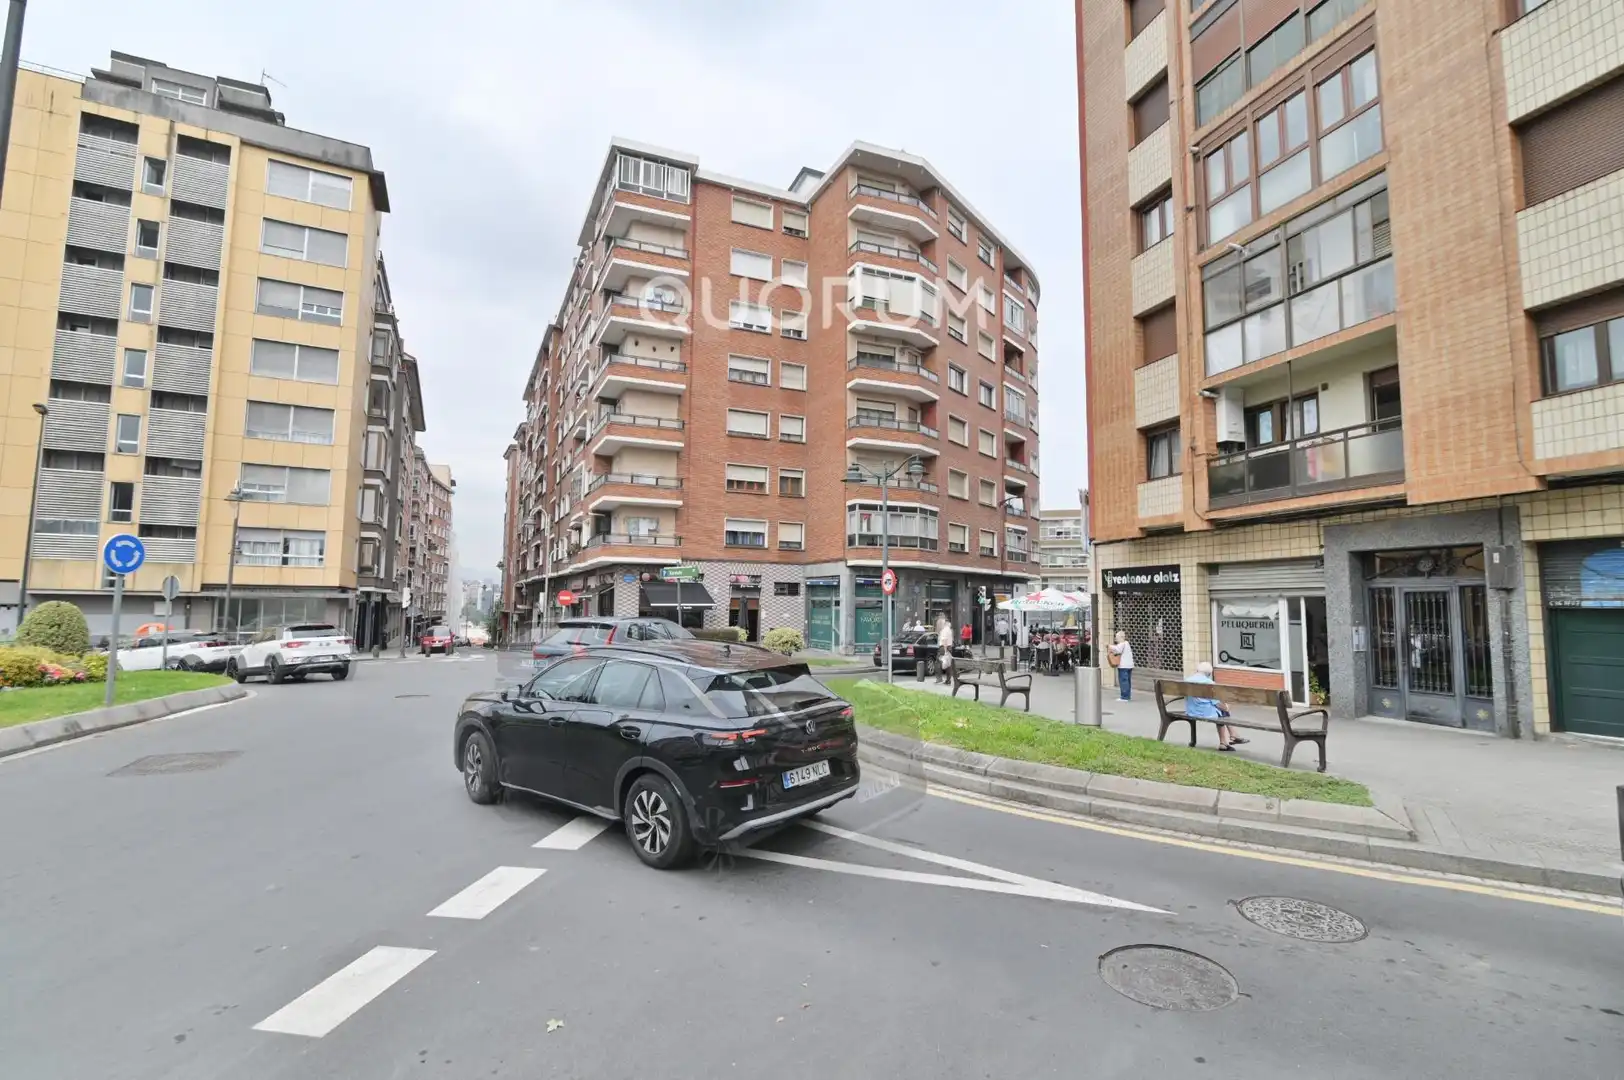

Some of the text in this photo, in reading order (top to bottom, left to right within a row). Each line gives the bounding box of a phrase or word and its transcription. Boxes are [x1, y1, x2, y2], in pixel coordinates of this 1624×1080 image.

[1113, 571, 1179, 584] ventanas olatz
[1221, 620, 1274, 629] PELUQUERIA
[789, 763, 827, 784] 6149 NLC
